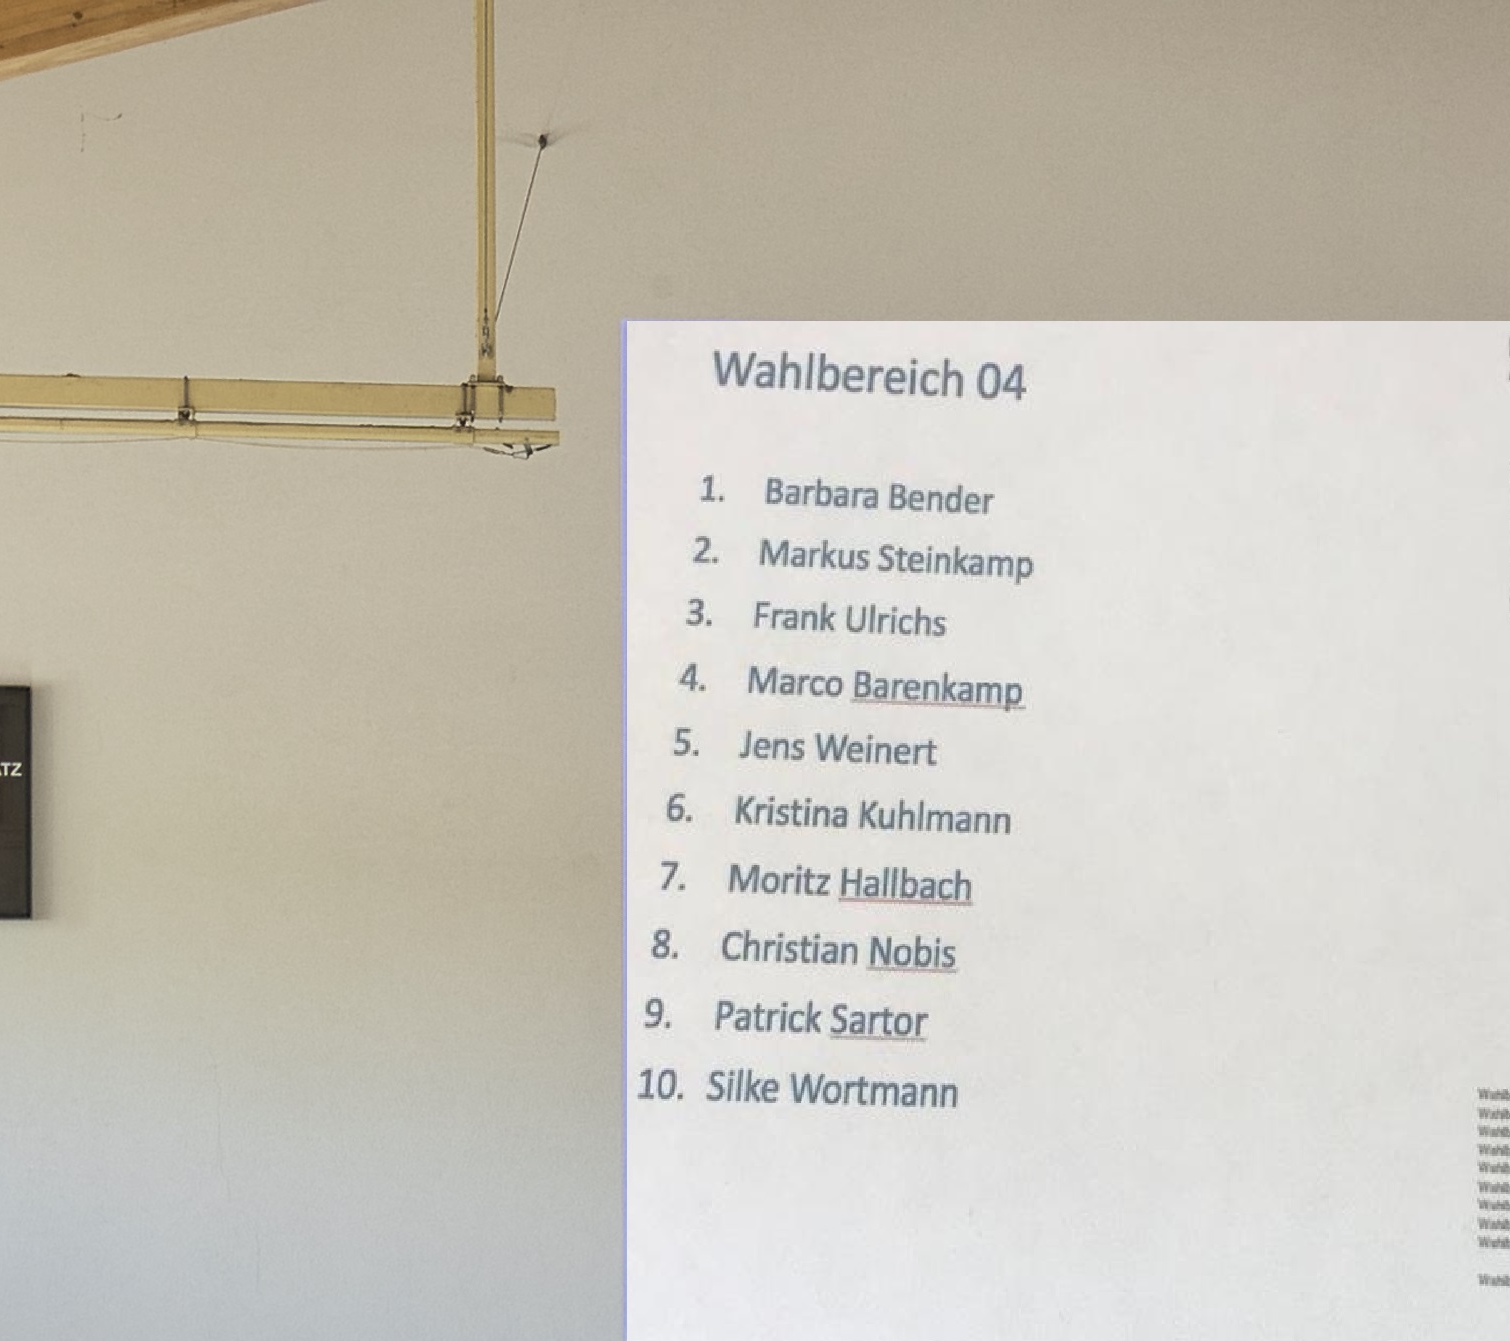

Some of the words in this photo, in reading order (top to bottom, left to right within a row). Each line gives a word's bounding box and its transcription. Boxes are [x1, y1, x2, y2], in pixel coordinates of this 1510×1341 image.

[714, 352, 965, 398] Wahlbereich
[976, 363, 1027, 400] 04
[700, 475, 725, 503] 1.
[765, 478, 879, 511] Barbara
[888, 483, 993, 516] Bender
[694, 537, 720, 565] 2.
[760, 539, 870, 571] Markus
[878, 544, 1034, 582] Steinkamp
[686, 600, 714, 628] 3.
[753, 602, 836, 632] Frank
[845, 607, 946, 638] Ulrichs
[680, 664, 706, 693] 4.
[747, 667, 844, 698] Marco
[852, 672, 1024, 710] Barenkamp
[674, 728, 700, 758] 5.
[739, 730, 805, 762] Jens
[815, 733, 938, 767] Weinert
[667, 794, 693, 824] 6.
[735, 796, 849, 830] Kristina
[858, 801, 1011, 835] Kuhlmann
[660, 862, 687, 892] 7.
[728, 863, 830, 897] Moritz
[840, 869, 972, 902] Hallbach
[651, 929, 679, 960] 8.
[721, 931, 858, 966] Christian
[869, 937, 956, 969] Nobis
[644, 999, 672, 1030] 9.
[715, 1001, 821, 1035] Patrick
[831, 1004, 928, 1038] Sartor
[637, 1068, 685, 1101] 10.
[706, 1070, 779, 1104] Silke
[790, 1073, 958, 1109] Wortmann
